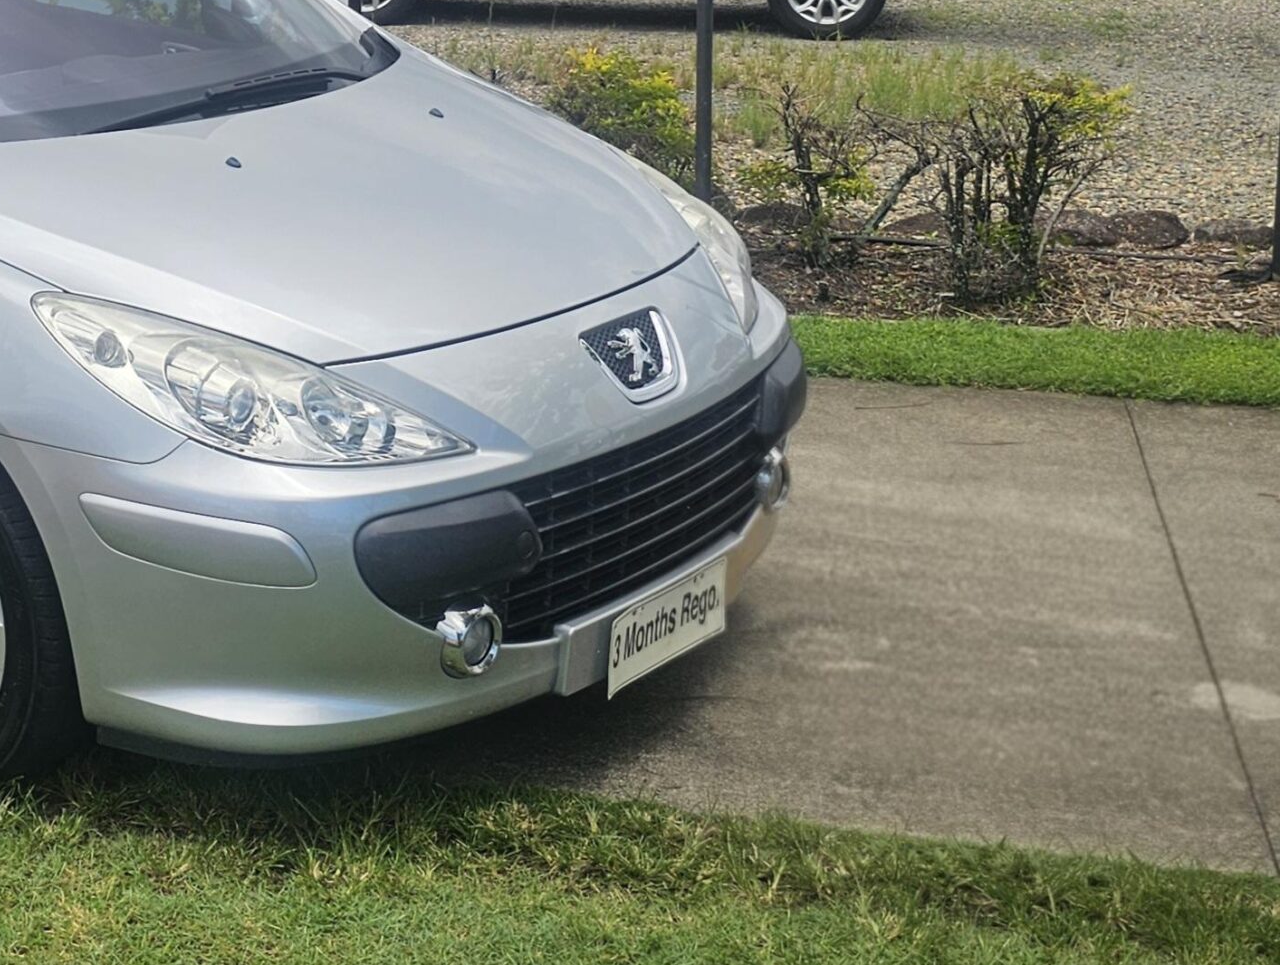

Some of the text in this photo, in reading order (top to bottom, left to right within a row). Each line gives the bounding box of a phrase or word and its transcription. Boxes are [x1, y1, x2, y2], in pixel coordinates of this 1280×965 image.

[612, 584, 720, 669] 3 Months Rego.
